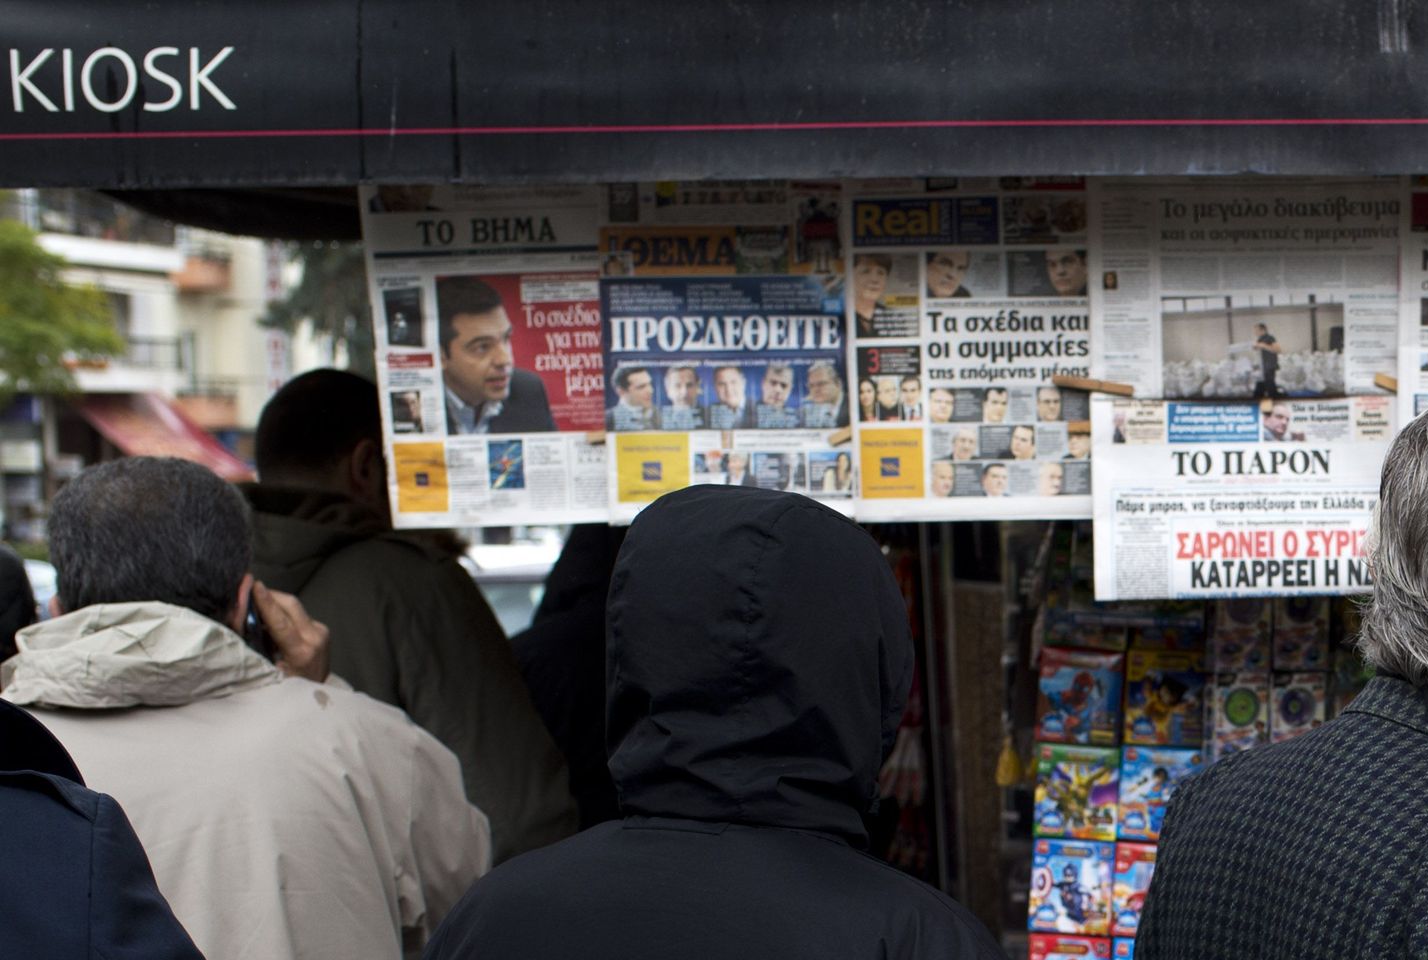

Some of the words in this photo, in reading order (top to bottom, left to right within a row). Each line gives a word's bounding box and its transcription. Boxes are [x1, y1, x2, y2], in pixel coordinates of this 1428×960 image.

[10, 47, 237, 112] KIOSK
[856, 202, 942, 237] Real
[1160, 198, 1186, 219] Το
[1193, 198, 1268, 223] μεγάλο
[1274, 195, 1400, 221] διακύβευμα
[416, 218, 455, 246] ΤΟ
[470, 216, 557, 244] ΒΗΜΑ
[622, 236, 736, 267] ΘΕΜΑ
[521, 304, 546, 329] Το
[927, 312, 957, 333] Τα
[965, 308, 1044, 333] σχέδια
[1051, 313, 1089, 332] και
[545, 332, 571, 353] για
[573, 330, 601, 348] την
[610, 316, 842, 353] ΠΡΟΣΔΕΘΕΙΤΕ
[928, 341, 950, 358] οι
[958, 334, 1089, 363] συμμαχίες
[535, 349, 603, 371] επόμενη
[929, 367, 955, 381] της
[960, 362, 1037, 382] επόμενης
[1172, 451, 1212, 476] ΤΟ
[1223, 449, 1331, 476] ΠΑΡΟΝ
[1323, 497, 1365, 510] Ελλάδα
[1176, 530, 1275, 560] ΣΑΡΩΝΕΙ
[1283, 530, 1299, 558] Ο
[1191, 559, 1317, 588] ΚΑΤΑΡΡΕΕΙ
[1325, 559, 1339, 587] Η
